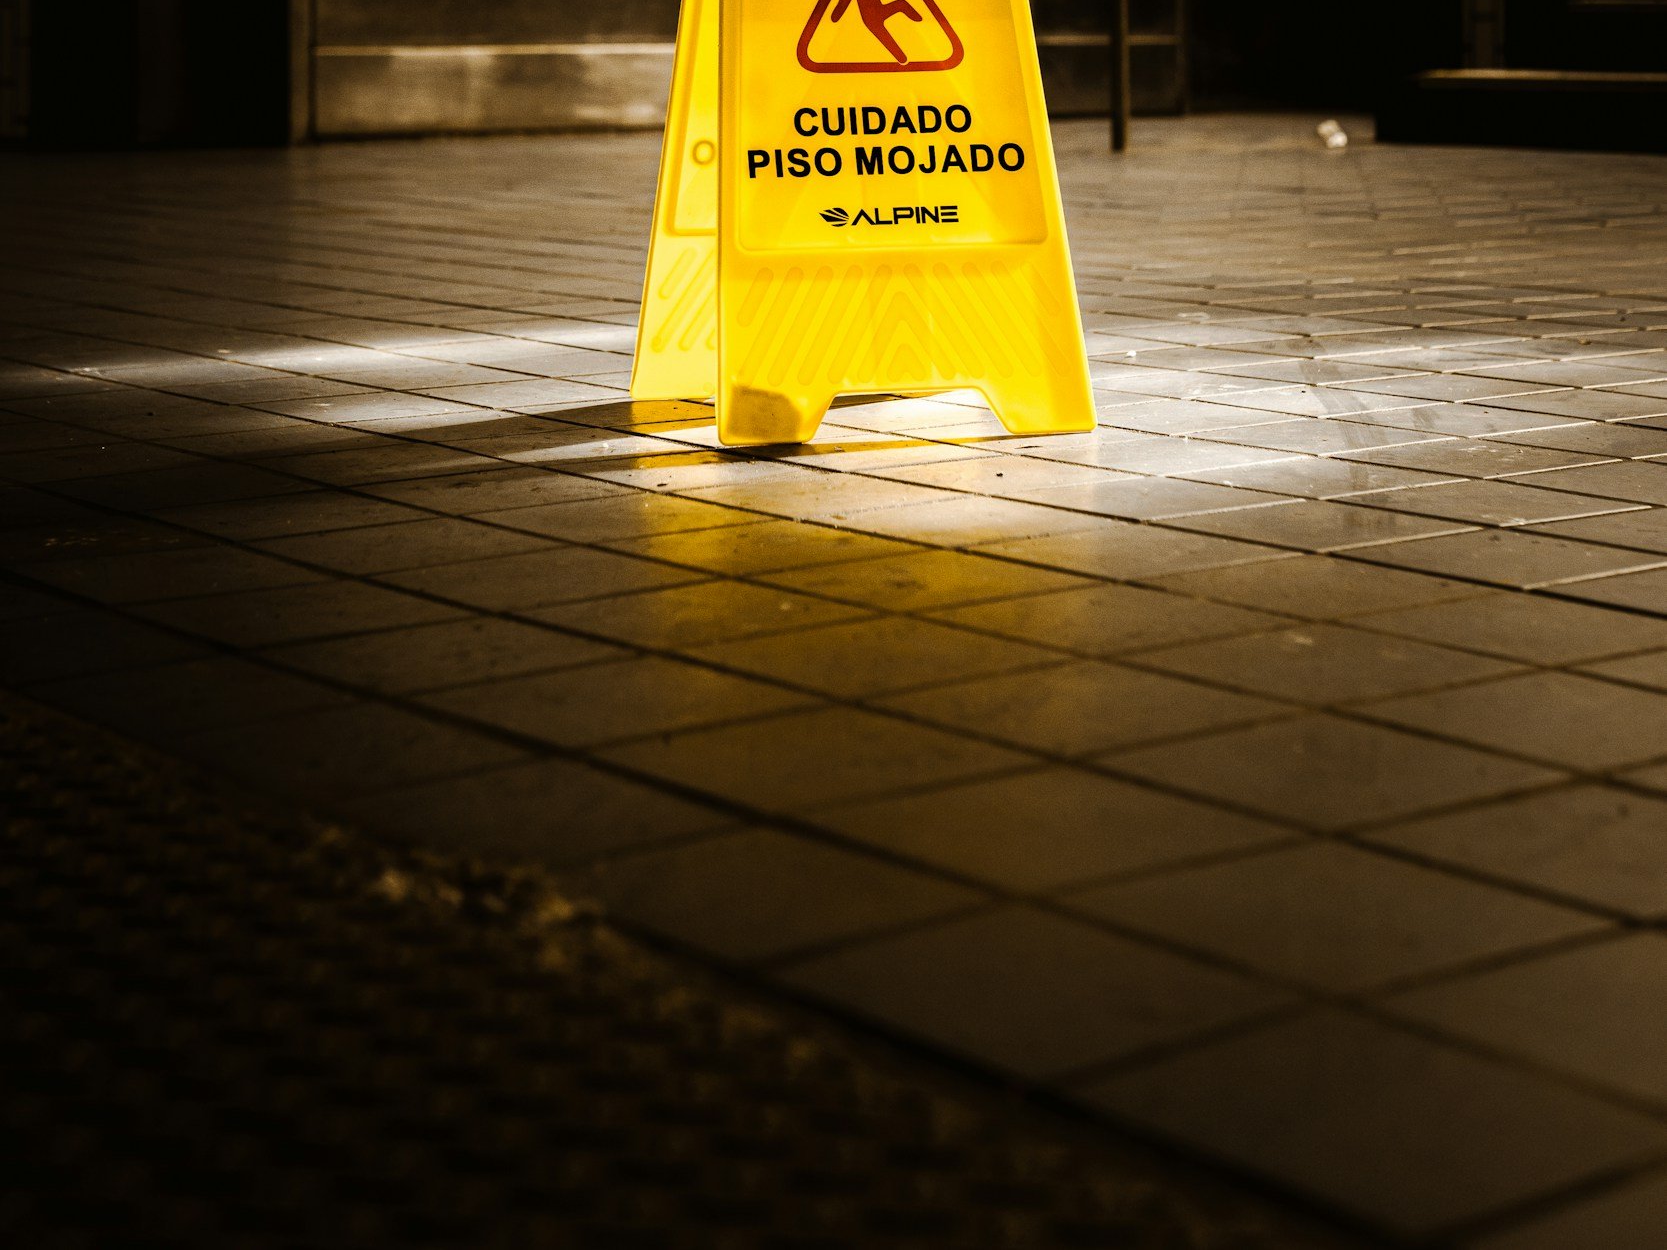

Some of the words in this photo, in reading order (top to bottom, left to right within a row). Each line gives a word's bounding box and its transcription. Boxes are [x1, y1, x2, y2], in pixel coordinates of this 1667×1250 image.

[793, 103, 973, 137] CUIDADO
[747, 146, 843, 179] PISO
[854, 142, 1026, 176] MOJADO
[850, 205, 959, 226] ALPINE
